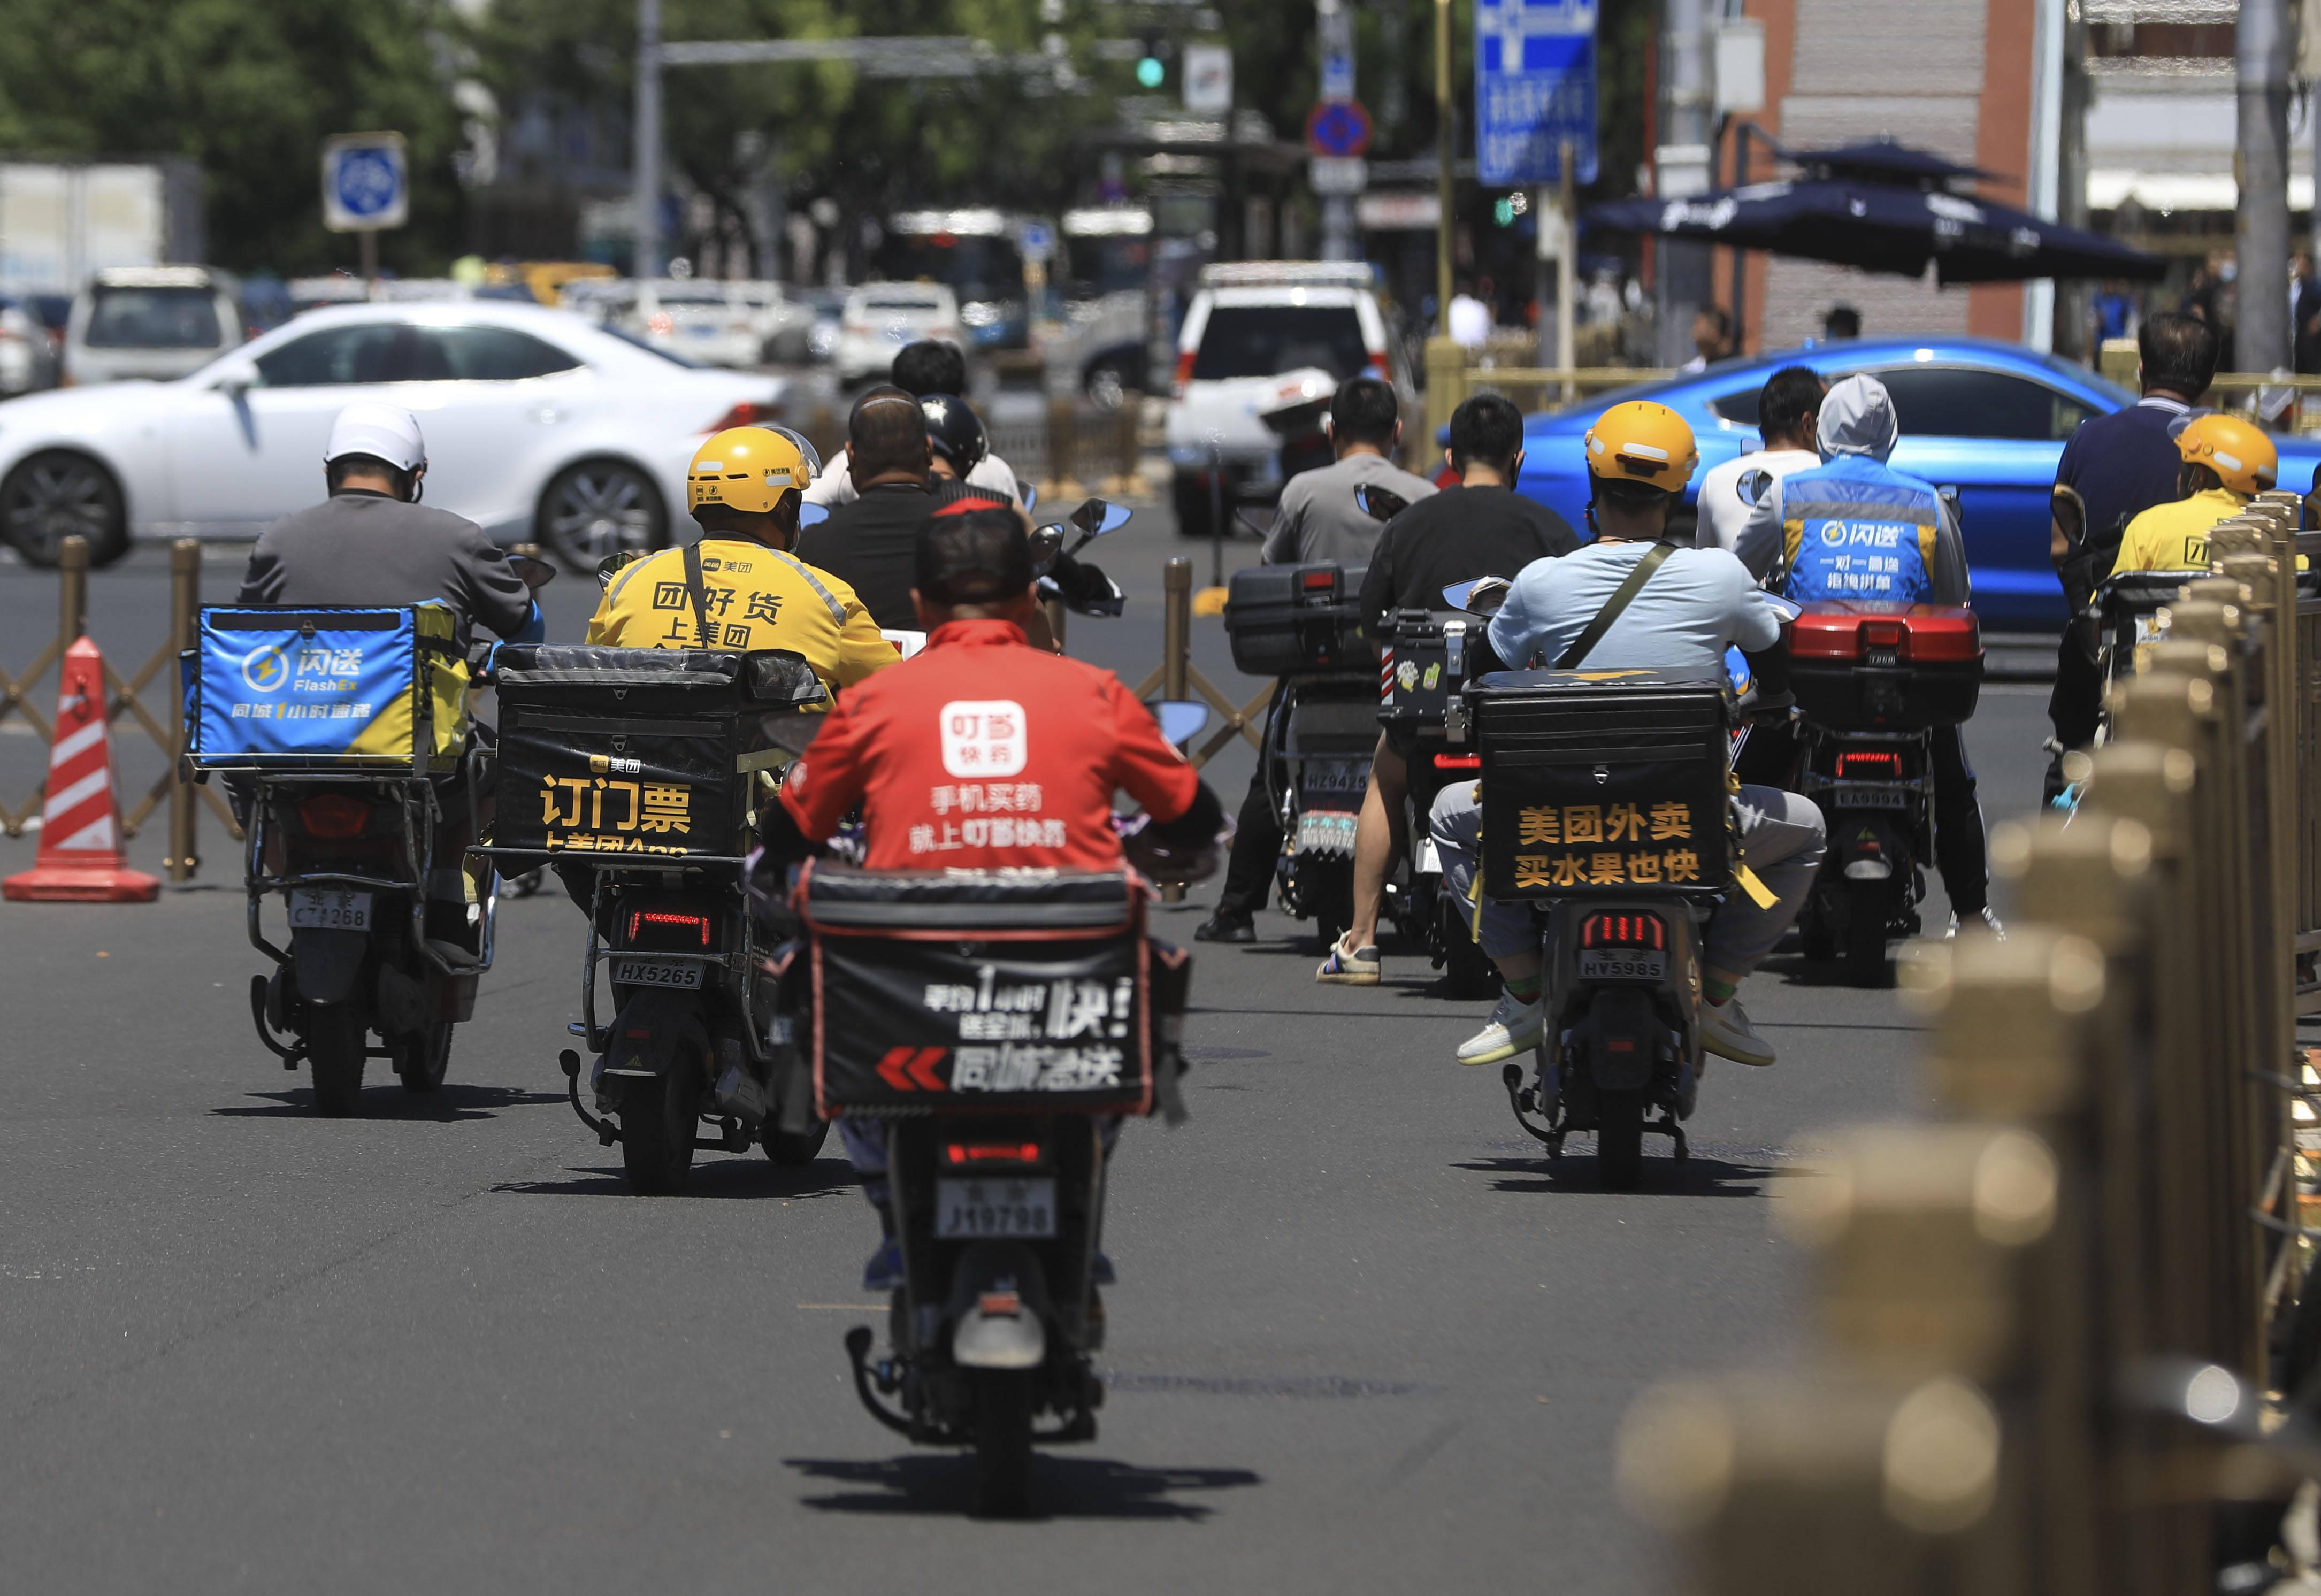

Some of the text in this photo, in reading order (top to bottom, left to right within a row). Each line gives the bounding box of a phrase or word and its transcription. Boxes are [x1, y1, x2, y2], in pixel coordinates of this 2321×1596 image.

[1849, 524, 1899, 548] 闪送
[723, 561, 753, 573] 美团
[652, 581, 783, 625] 团好货
[662, 617, 752, 649] 上美团
[296, 648, 363, 676] 闪送
[292, 679, 358, 692] FlashEx
[611, 757, 640, 773] 美团
[540, 774, 691, 834] 订门票
[930, 782, 1042, 815] 手机买药
[1519, 801, 1692, 845] 美团外卖
[1515, 848, 1700, 888] 买水果也快
[621, 964, 696, 985] HX5265
